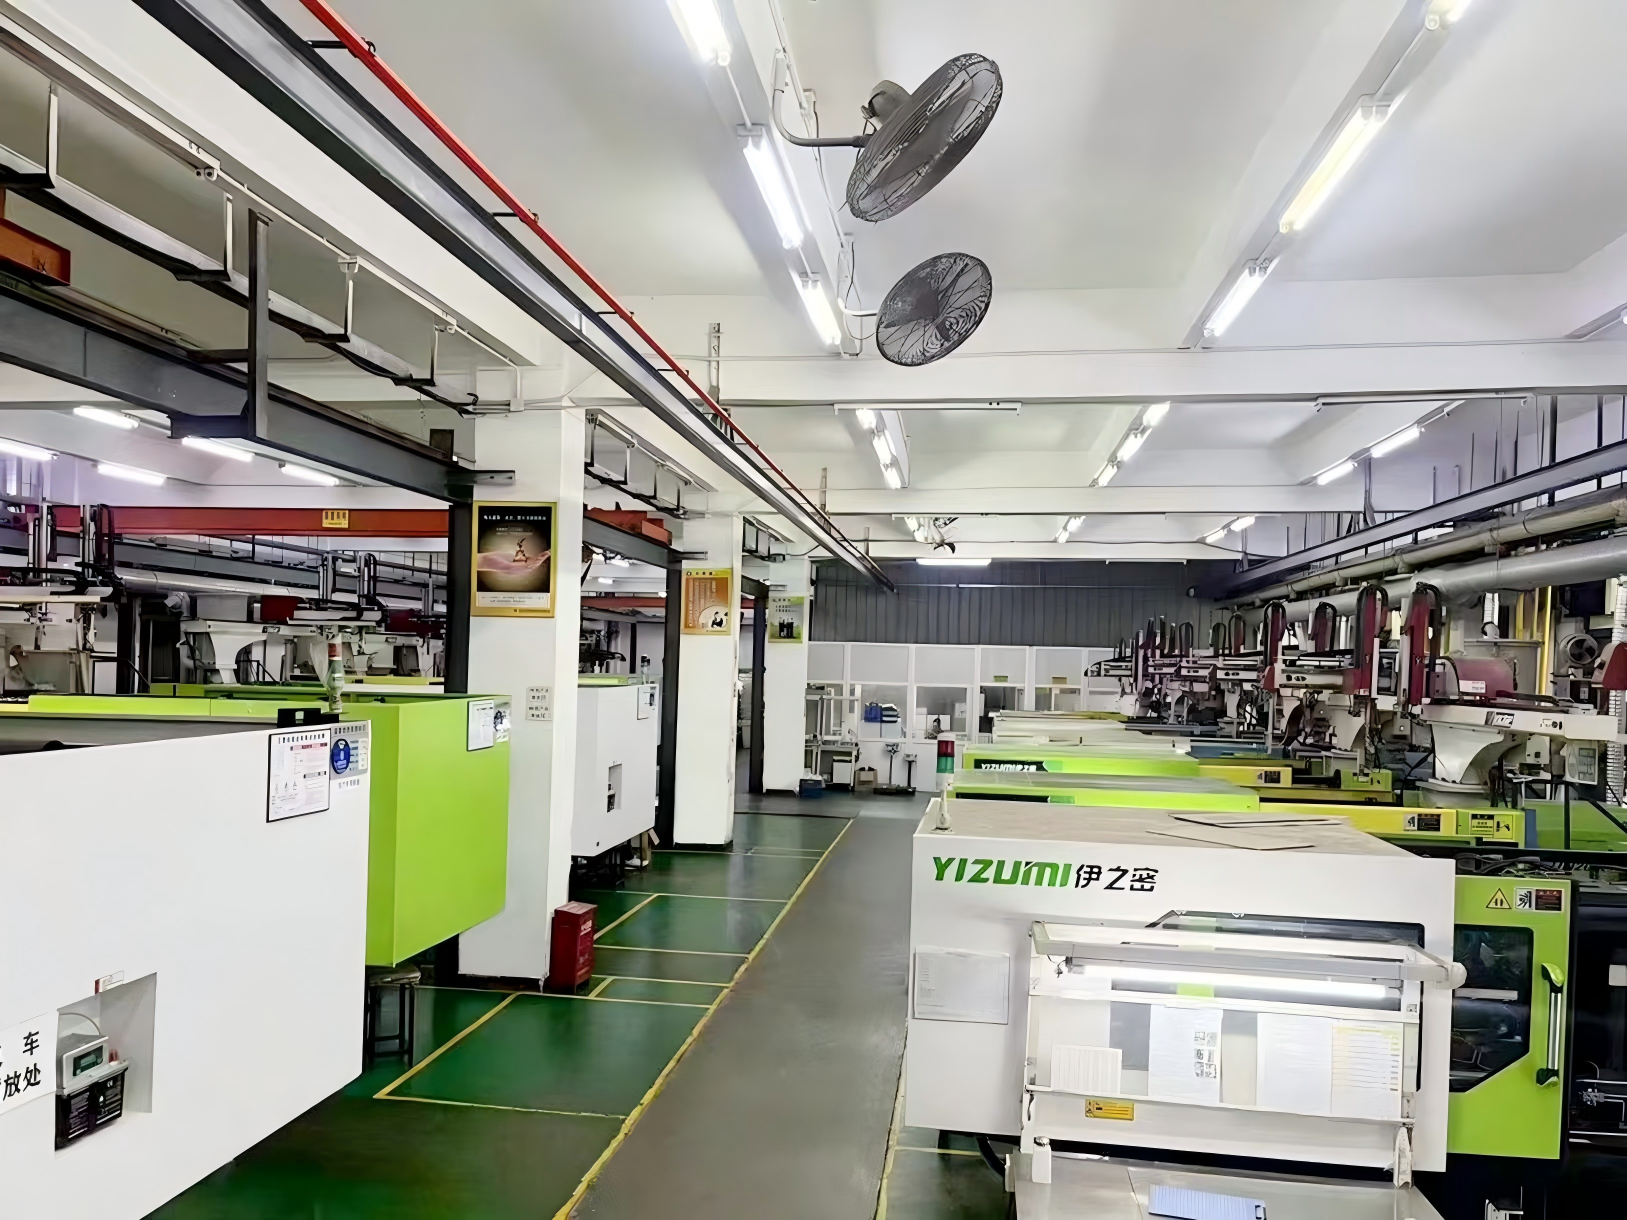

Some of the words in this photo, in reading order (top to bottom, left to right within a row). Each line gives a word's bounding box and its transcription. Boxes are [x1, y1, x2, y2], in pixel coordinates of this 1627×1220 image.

[932, 856, 1073, 888] YIZUMI
[1074, 863, 1159, 892] 伊之密
[0, 1062, 42, 1102] 放处
